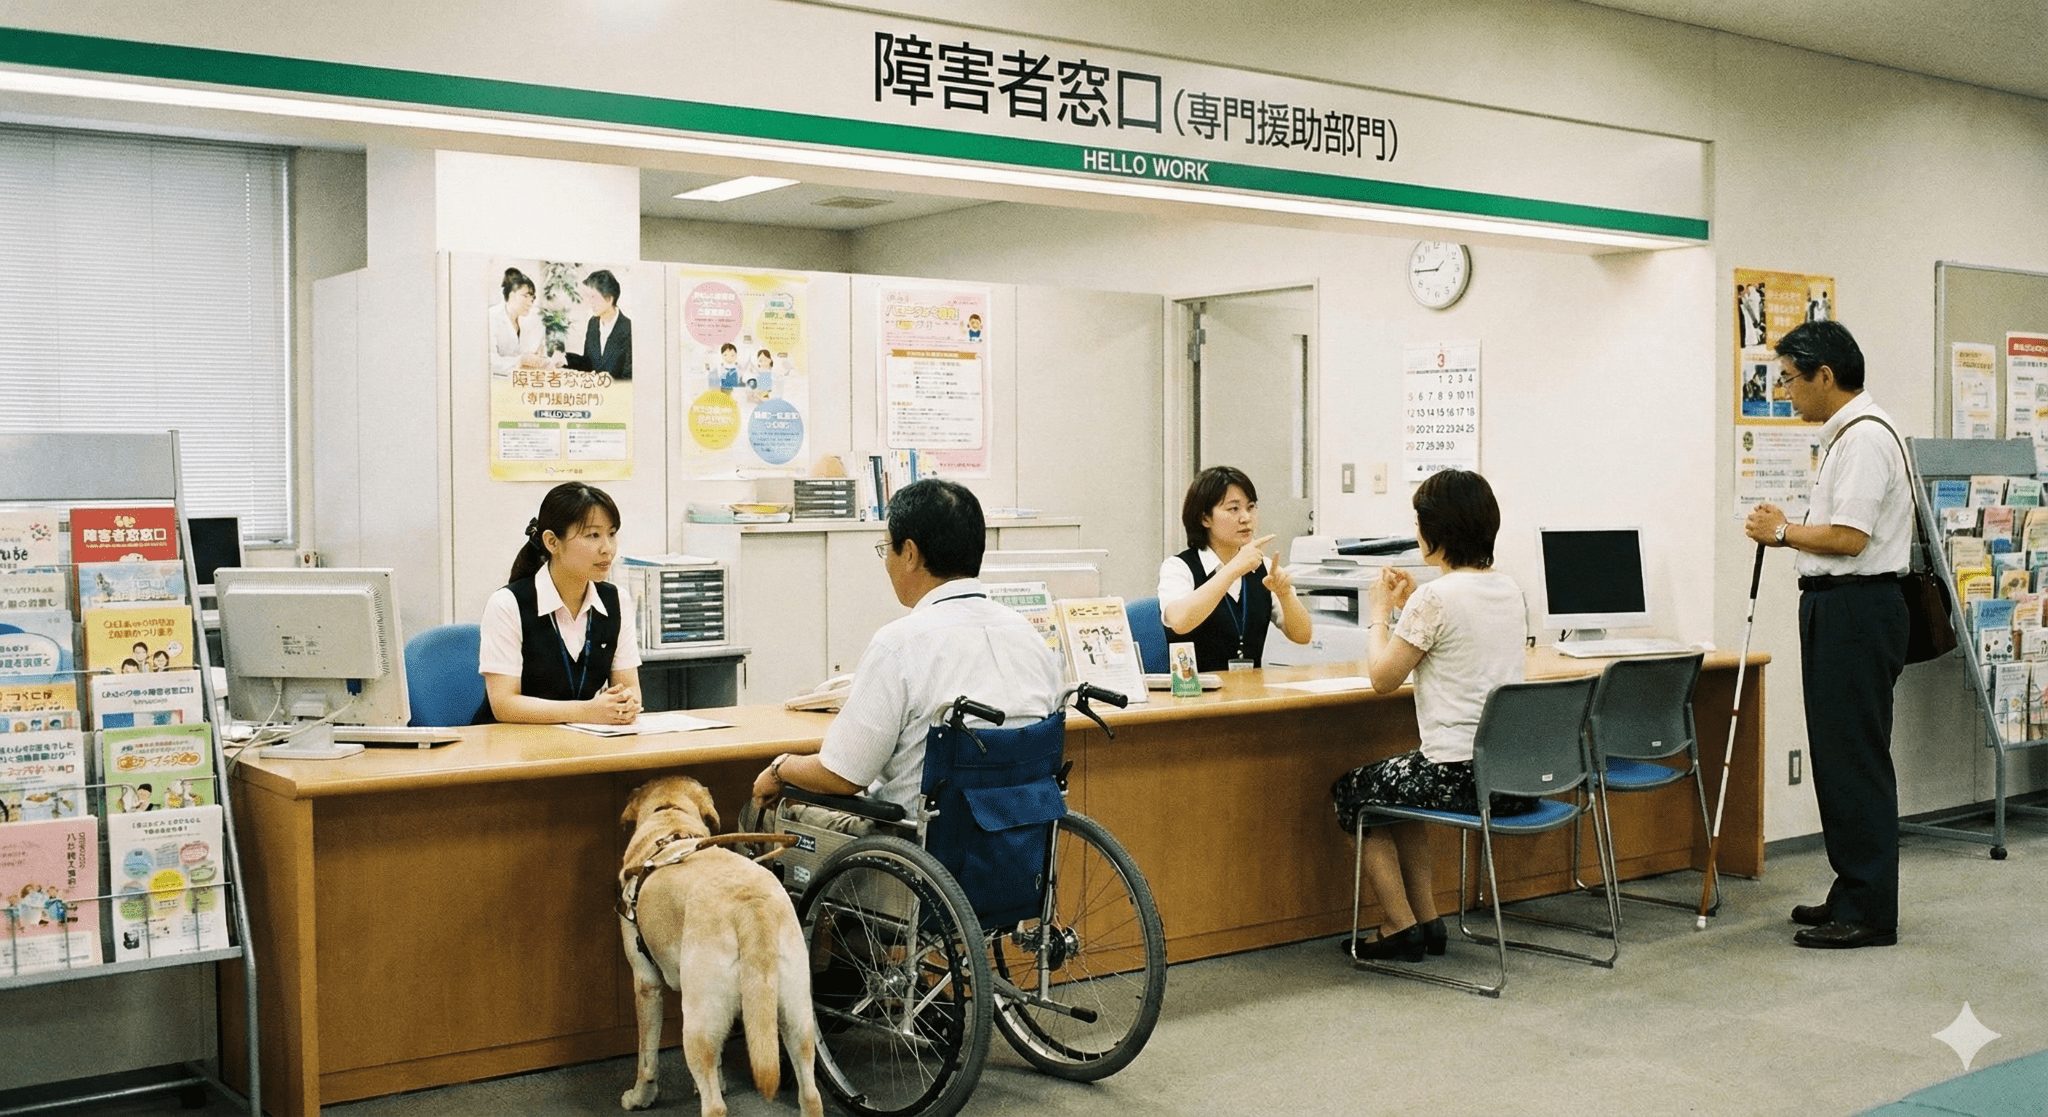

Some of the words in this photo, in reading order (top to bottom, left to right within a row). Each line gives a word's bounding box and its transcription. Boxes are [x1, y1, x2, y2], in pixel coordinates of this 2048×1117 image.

[872, 31, 1163, 134] 障害者窓口
[1173, 88, 1399, 162] (専門援助部門)
[1083, 149, 1147, 176] HELLO
[1152, 157, 1210, 183] WORK
[1437, 353, 1445, 368] 3
[1438, 375, 1443, 384] 1
[1448, 374, 1454, 384] 2
[1458, 374, 1463, 384] 3
[1468, 374, 1473, 383] 4
[1418, 391, 1424, 401] 6
[1428, 391, 1433, 401] 7
[1437, 391, 1443, 401] 8
[1448, 391, 1454, 400] 9
[1456, 390, 1465, 400] 10
[1466, 390, 1474, 399] 11
[1407, 409, 1414, 418] 12
[1416, 408, 1425, 418] 13
[1427, 408, 1435, 417] 14
[1436, 408, 1445, 417] 15
[1446, 408, 1455, 417] 16
[1456, 407, 1464, 417] 17
[1416, 425, 1425, 434] 20
[1426, 425, 1434, 434] 21
[1436, 424, 1445, 434] 22
[1446, 424, 1455, 434] 23
[1455, 424, 1464, 433] 24
[1466, 424, 1475, 433] 25
[1416, 441, 1425, 451] 27
